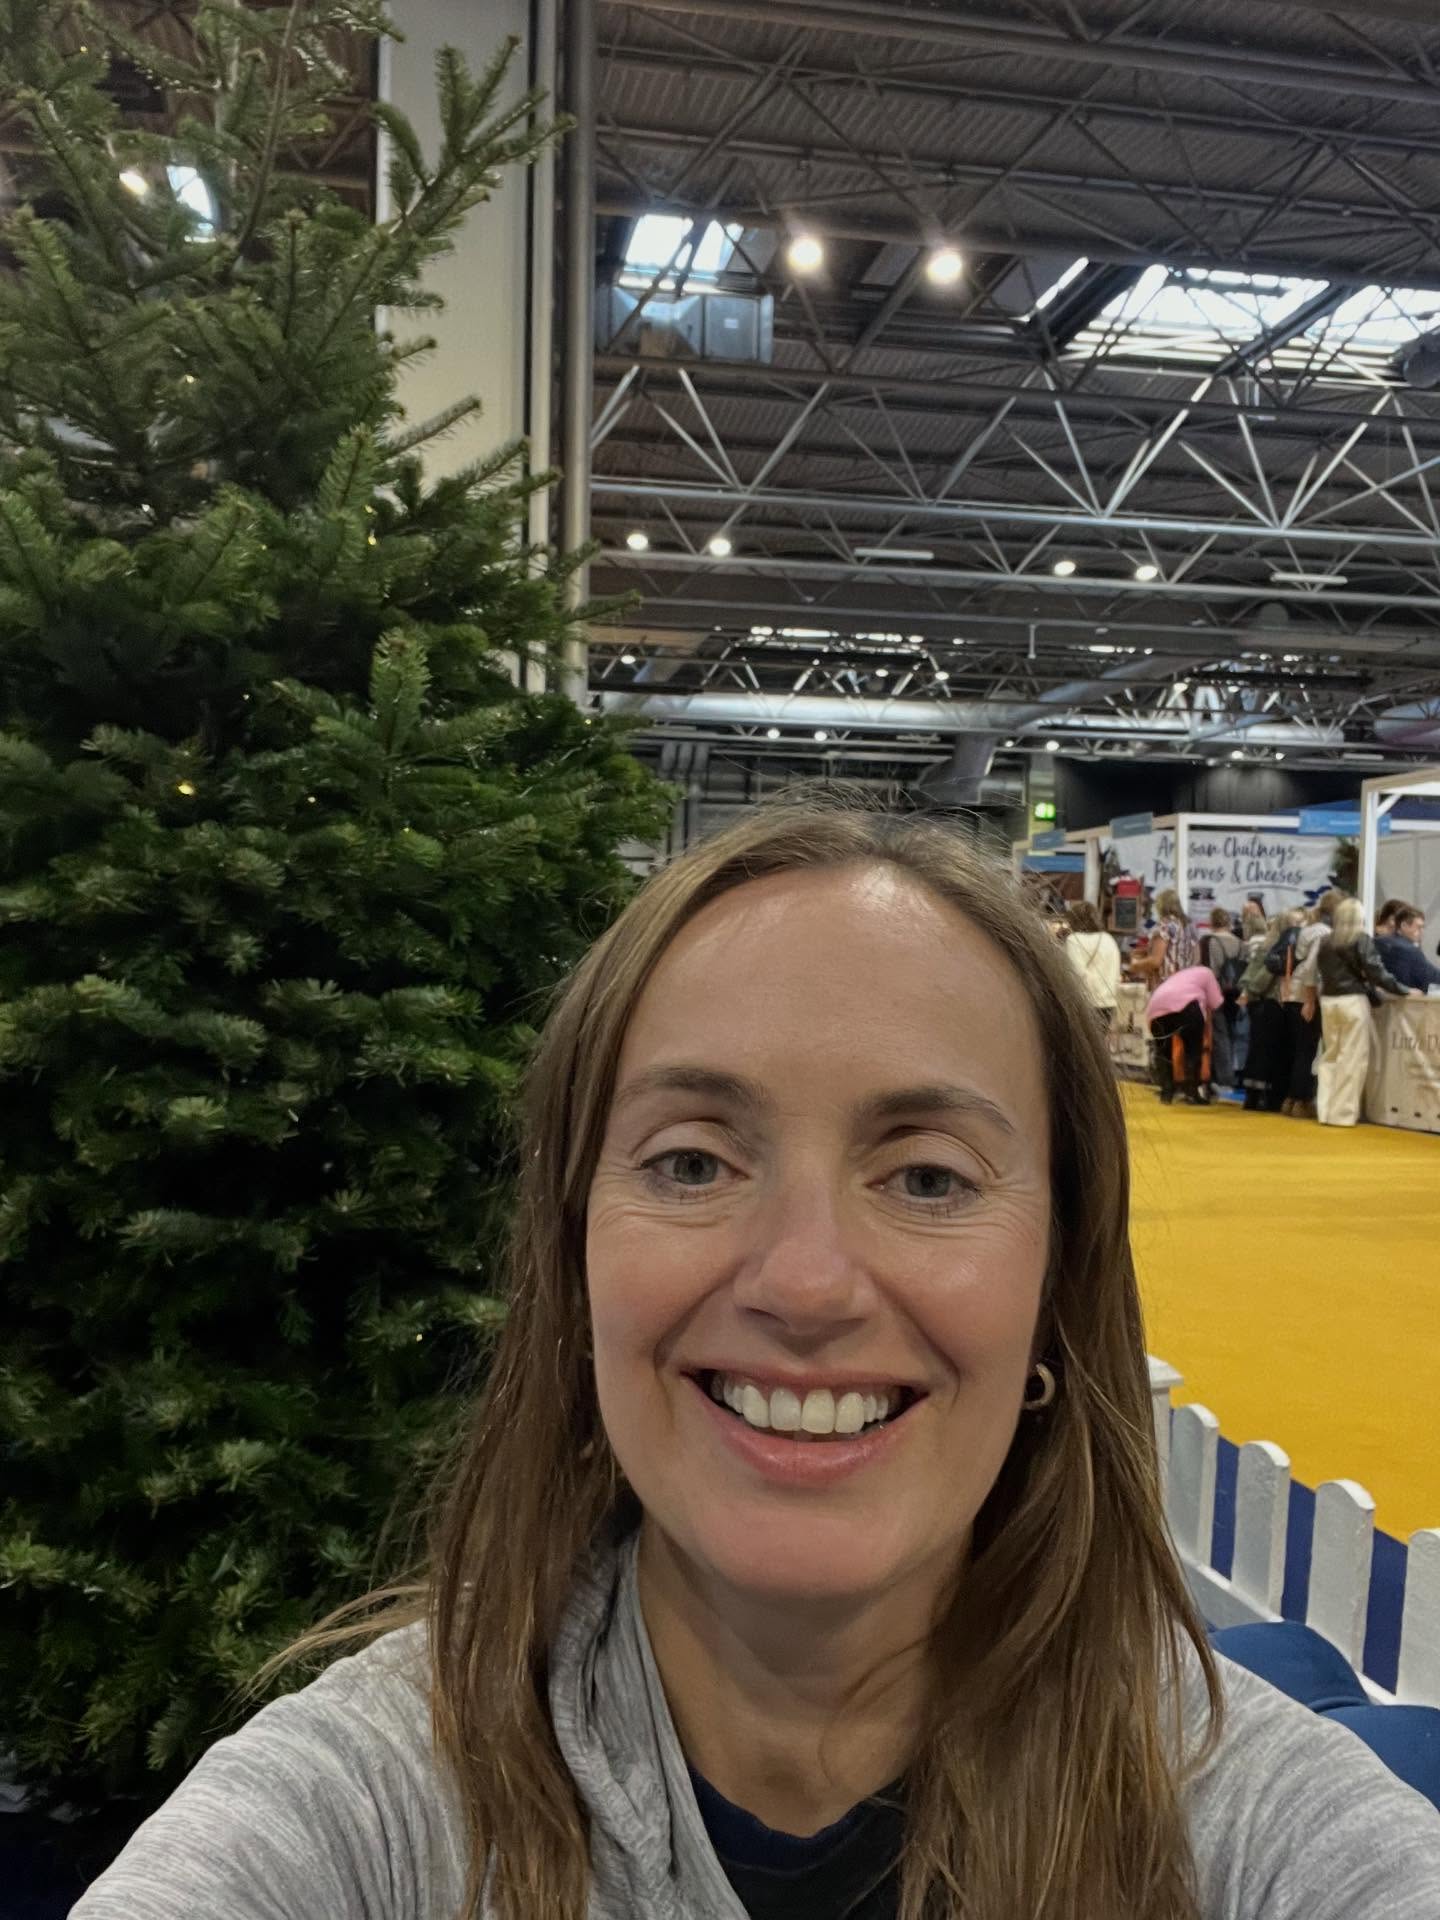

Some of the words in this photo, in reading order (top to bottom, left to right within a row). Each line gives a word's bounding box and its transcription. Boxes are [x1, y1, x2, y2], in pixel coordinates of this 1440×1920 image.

[1157, 834, 1218, 859] Arsan
[1152, 858, 1226, 884] Preerves
[1230, 859, 1241, 885] &
[1246, 860, 1303, 886] Cheeses
